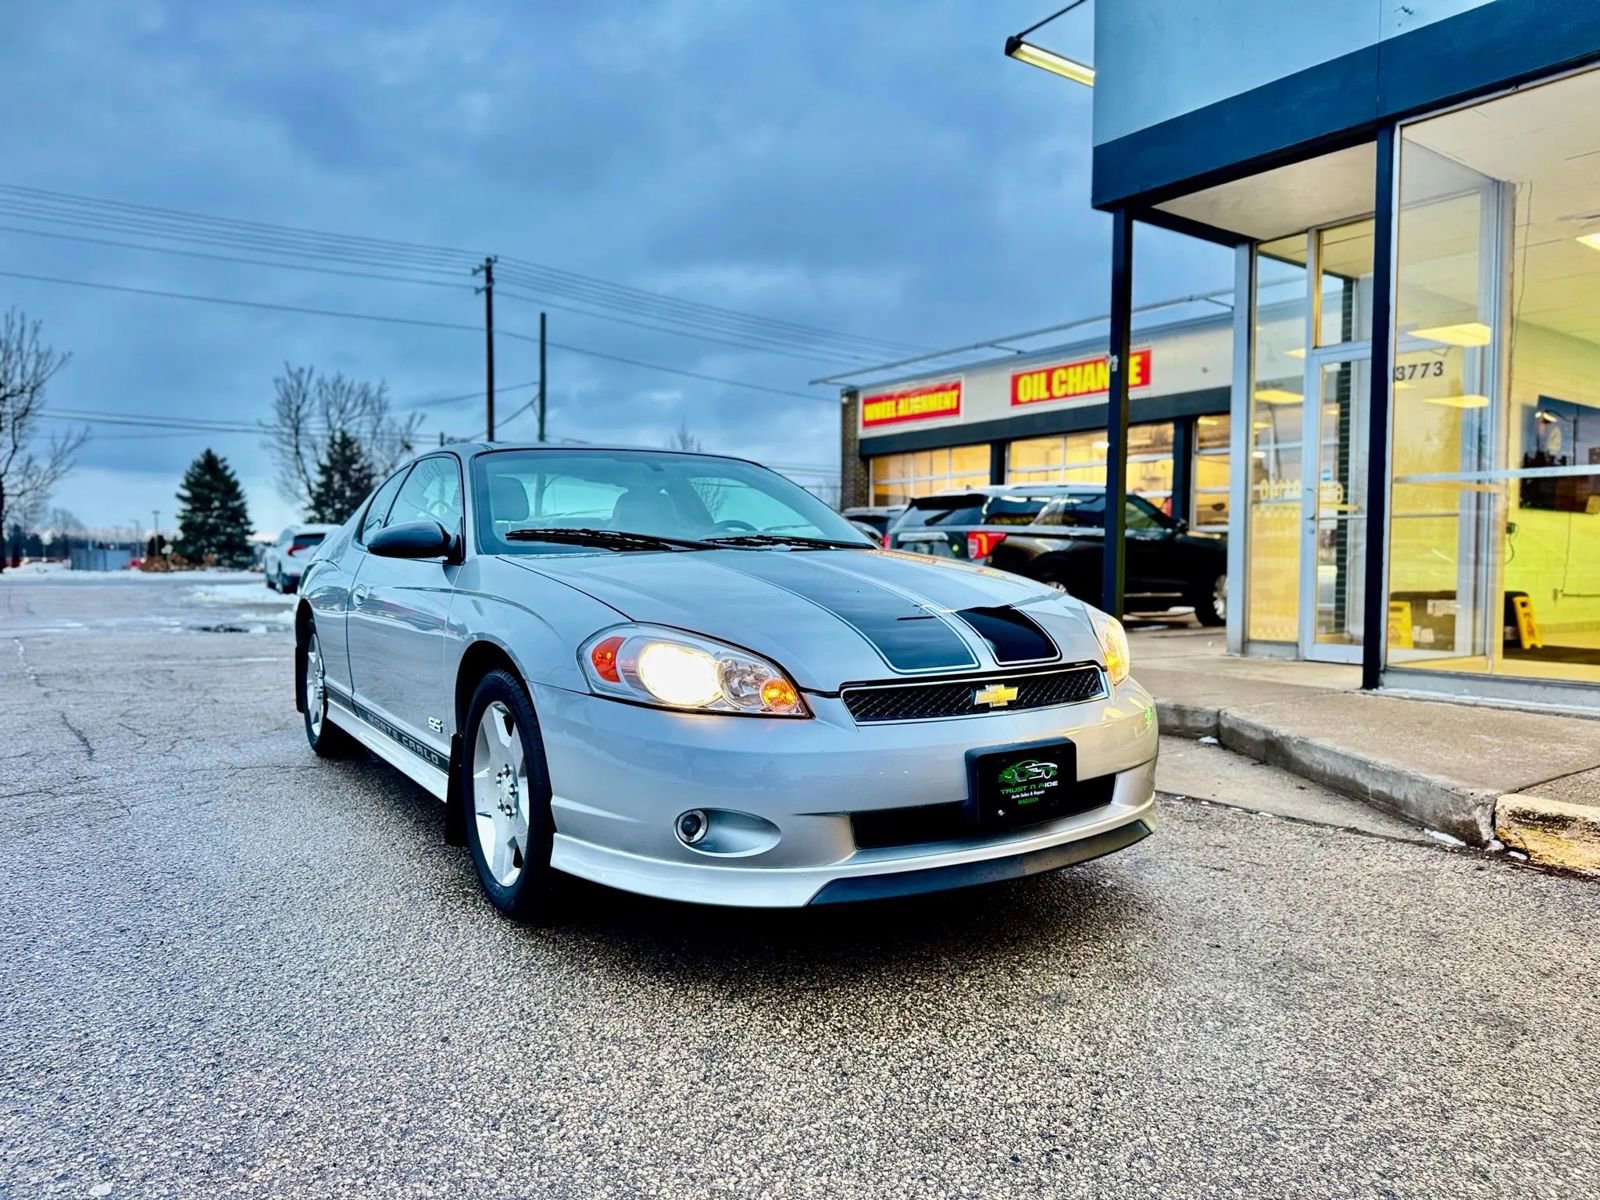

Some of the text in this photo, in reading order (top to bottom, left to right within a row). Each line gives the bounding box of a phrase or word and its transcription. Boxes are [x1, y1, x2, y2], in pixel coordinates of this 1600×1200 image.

[1017, 355, 1142, 403] OIL CHANE
[367, 713, 440, 765] MONTE CARLO
[1000, 785, 1028, 795] TRUST
[1038, 780, 1059, 788] RIDE
